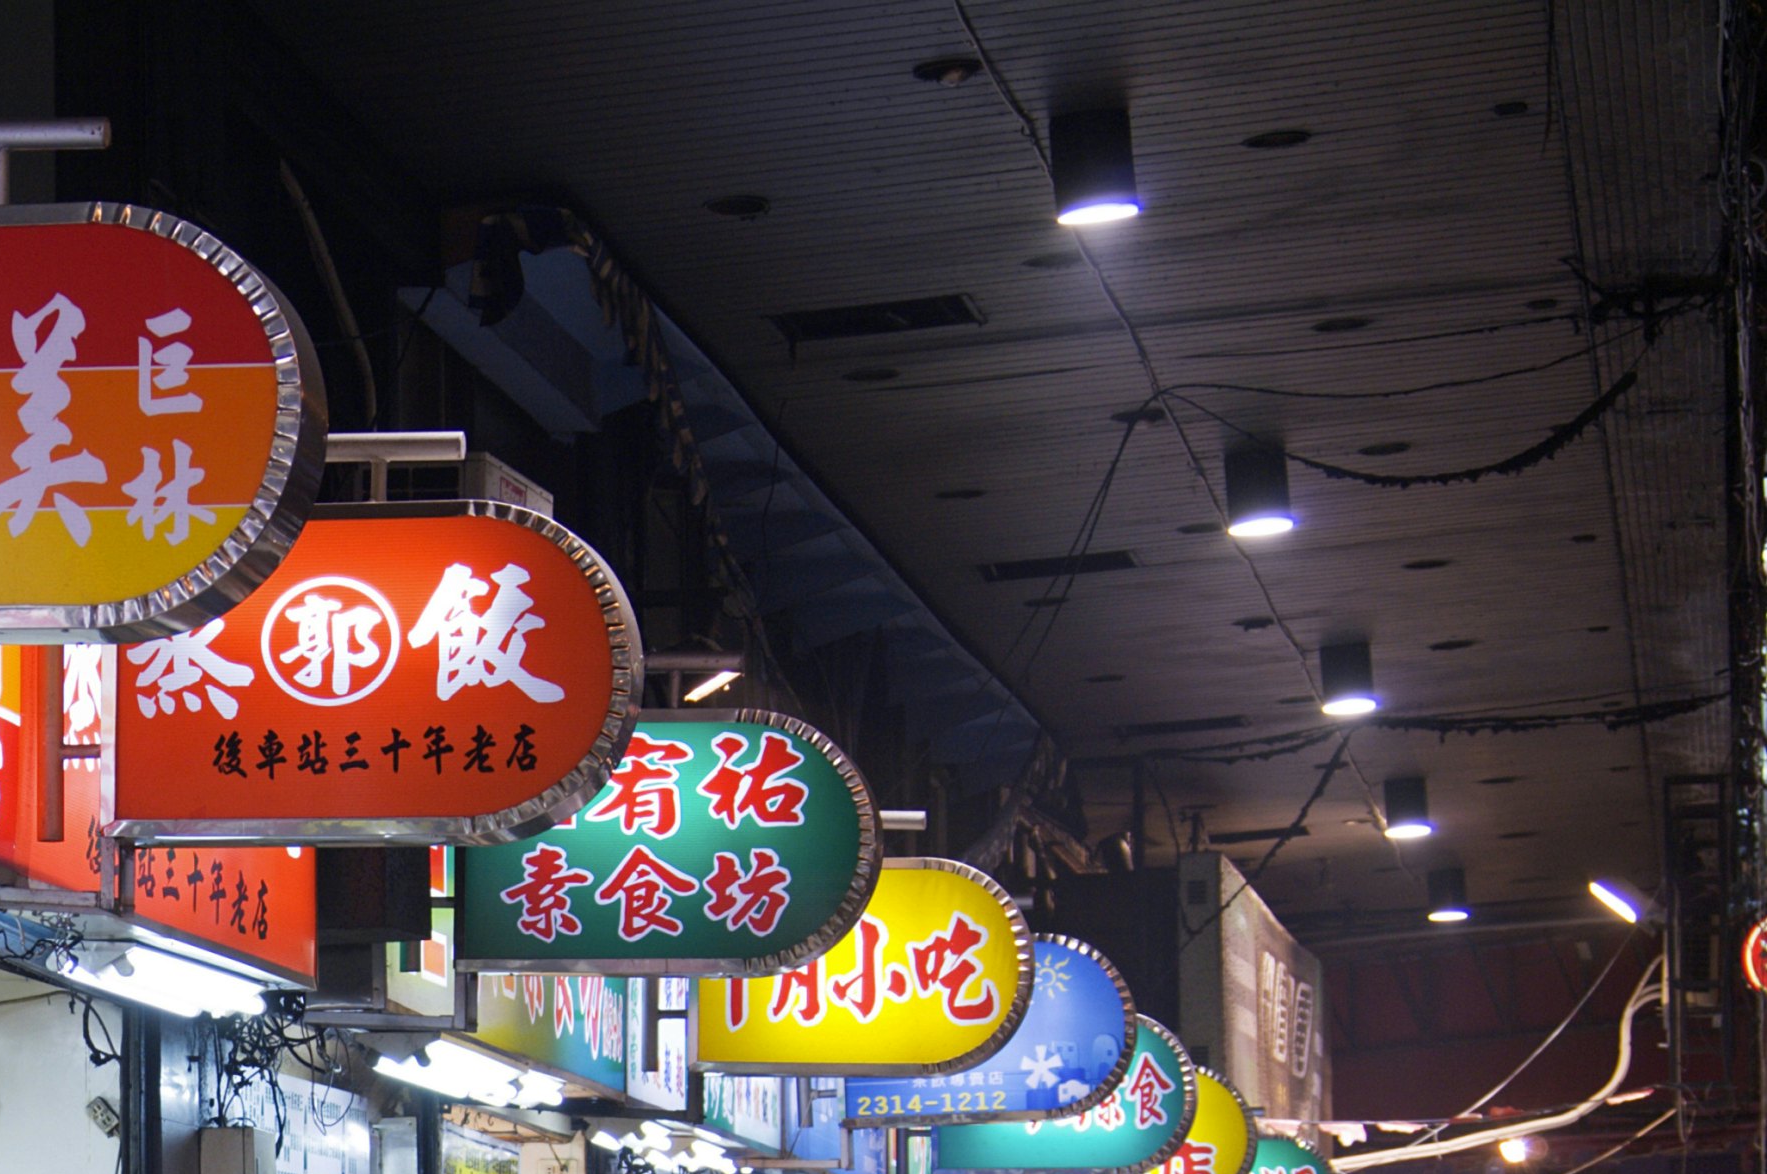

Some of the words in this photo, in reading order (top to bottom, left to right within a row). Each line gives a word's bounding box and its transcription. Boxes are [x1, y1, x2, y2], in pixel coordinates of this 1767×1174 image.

[122, 308, 217, 546] 巨林
[212, 723, 539, 779] 後車站三十年老店
[549, 732, 809, 840] 宥祐
[500, 842, 791, 943] 素食坊
[857, 1091, 1007, 1116] 2314-1212
